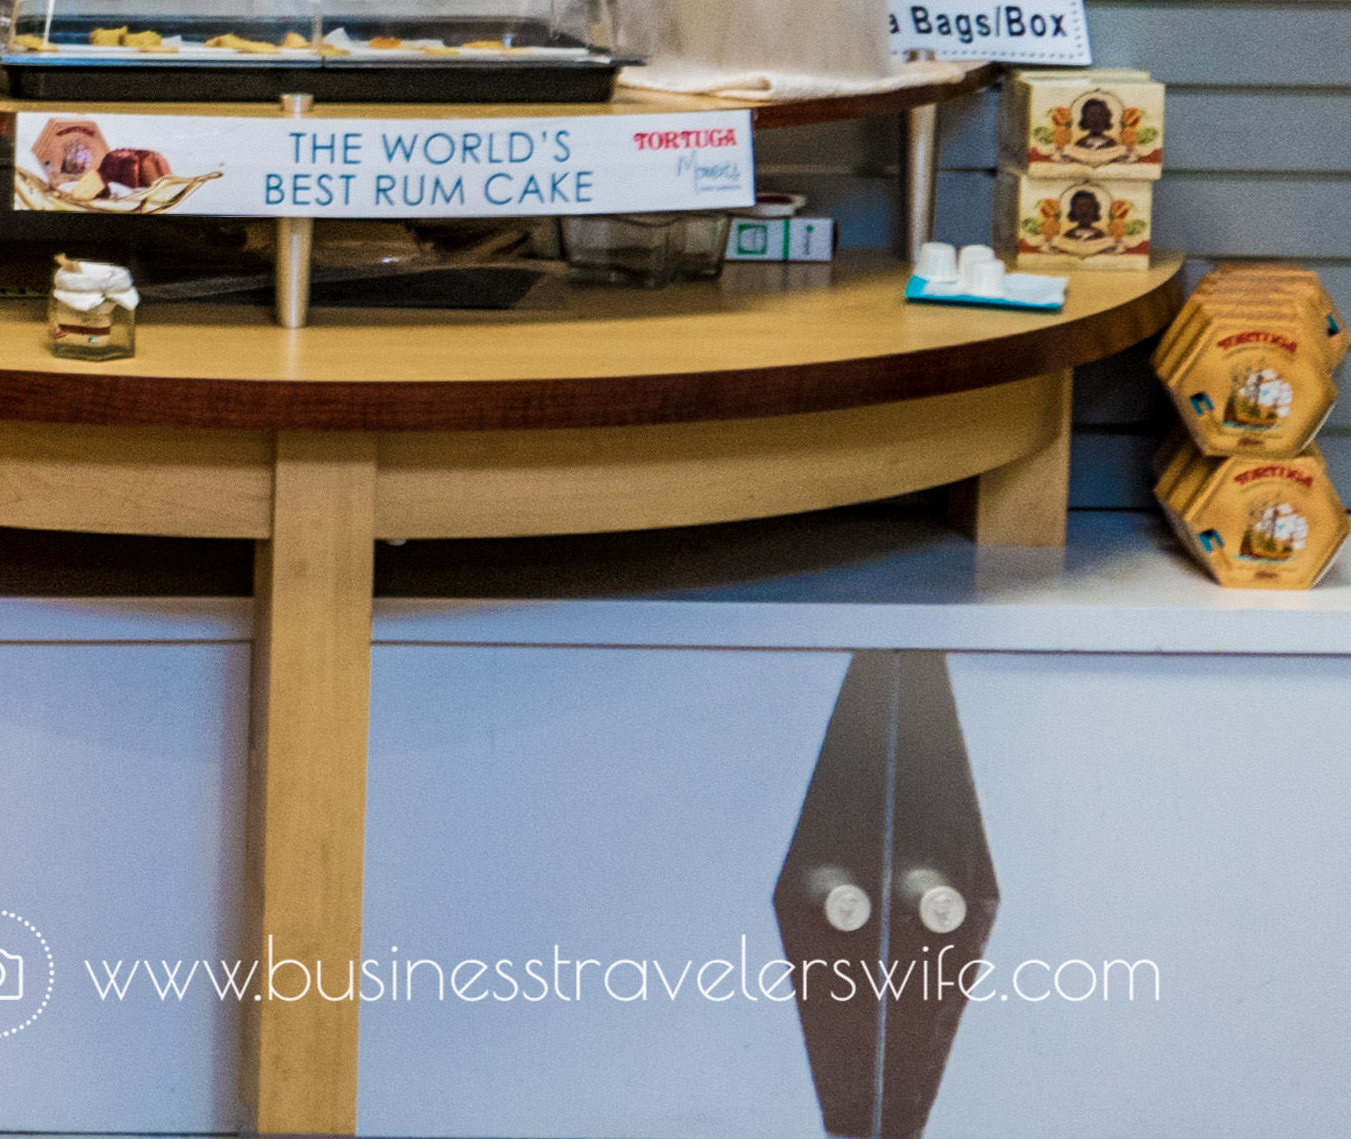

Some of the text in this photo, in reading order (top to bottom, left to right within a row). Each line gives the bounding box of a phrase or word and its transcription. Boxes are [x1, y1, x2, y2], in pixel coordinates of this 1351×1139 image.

[288, 127, 738, 165] THE WORLD'S TORTUGA
[264, 171, 594, 207] BEST RUM CAKE
